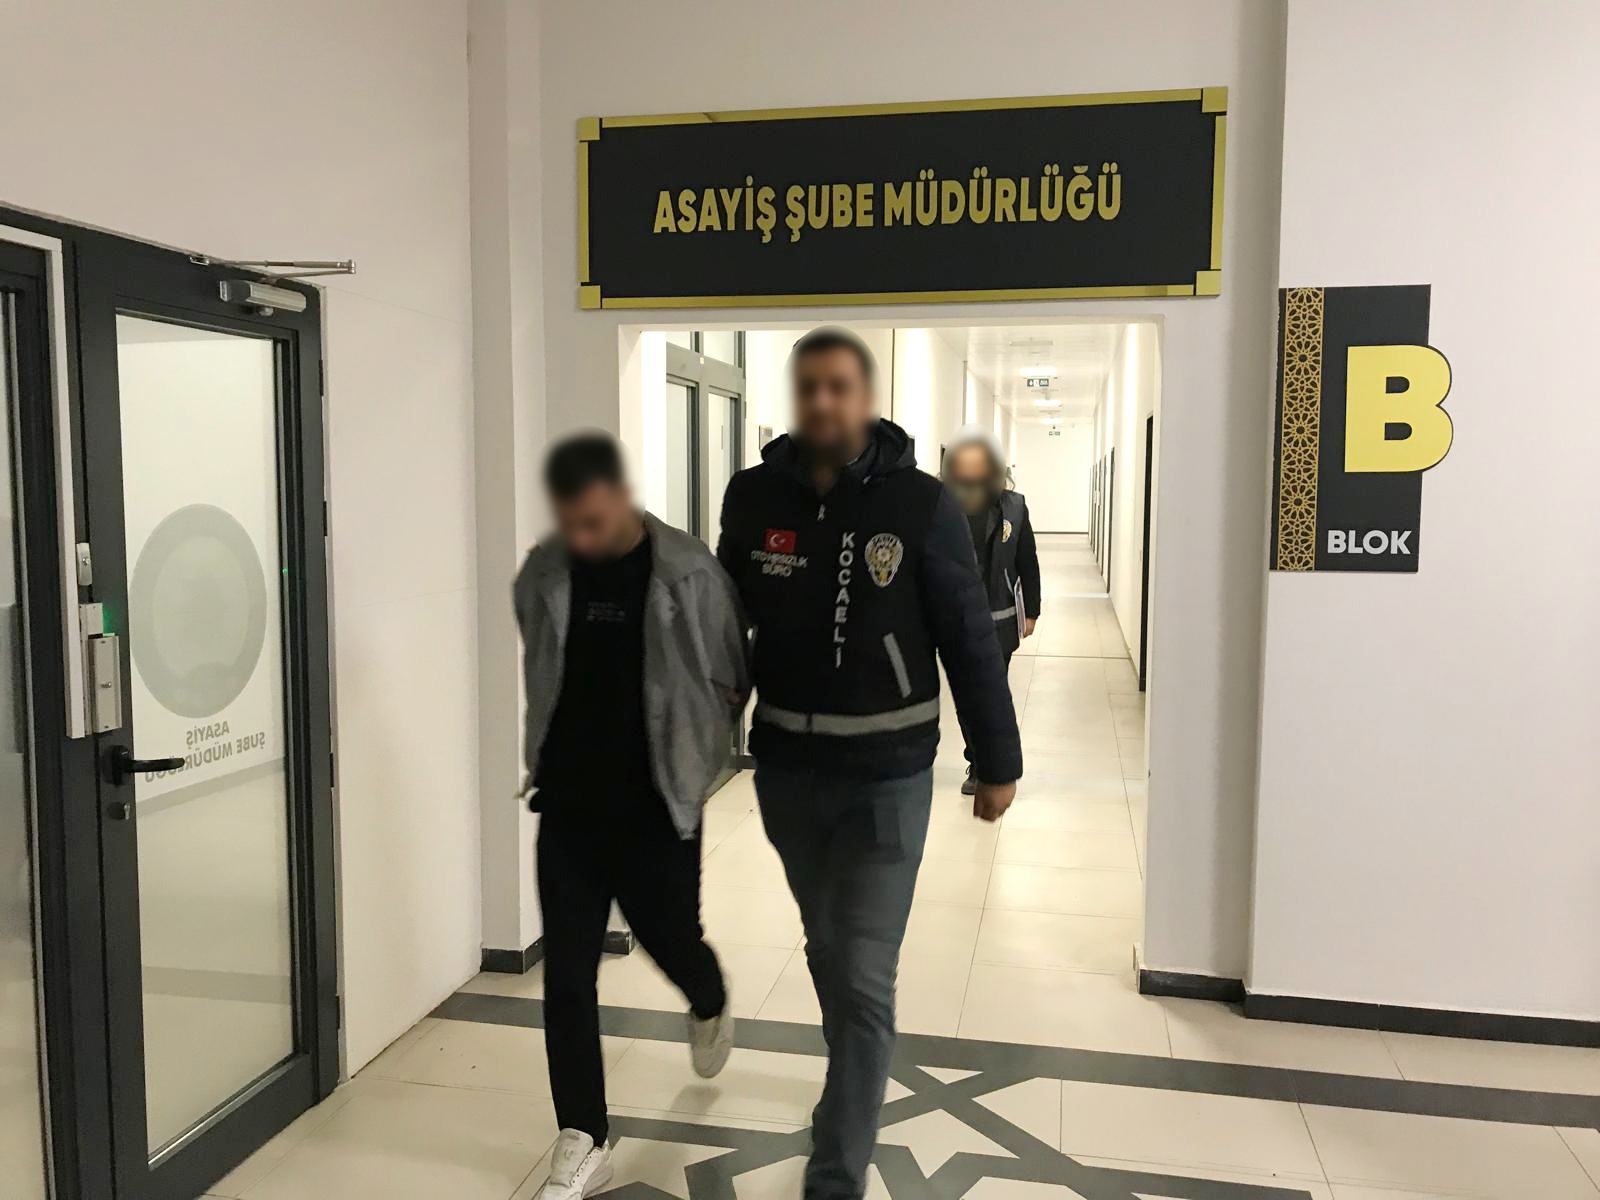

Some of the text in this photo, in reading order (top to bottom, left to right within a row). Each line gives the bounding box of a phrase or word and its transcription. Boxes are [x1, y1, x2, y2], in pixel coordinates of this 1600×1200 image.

[653, 162, 1121, 243] ASAYİŞ ŞUBE MÜDÜRLÜĞÜ
[1345, 344, 1453, 473] B
[1327, 530, 1412, 555] BLOK
